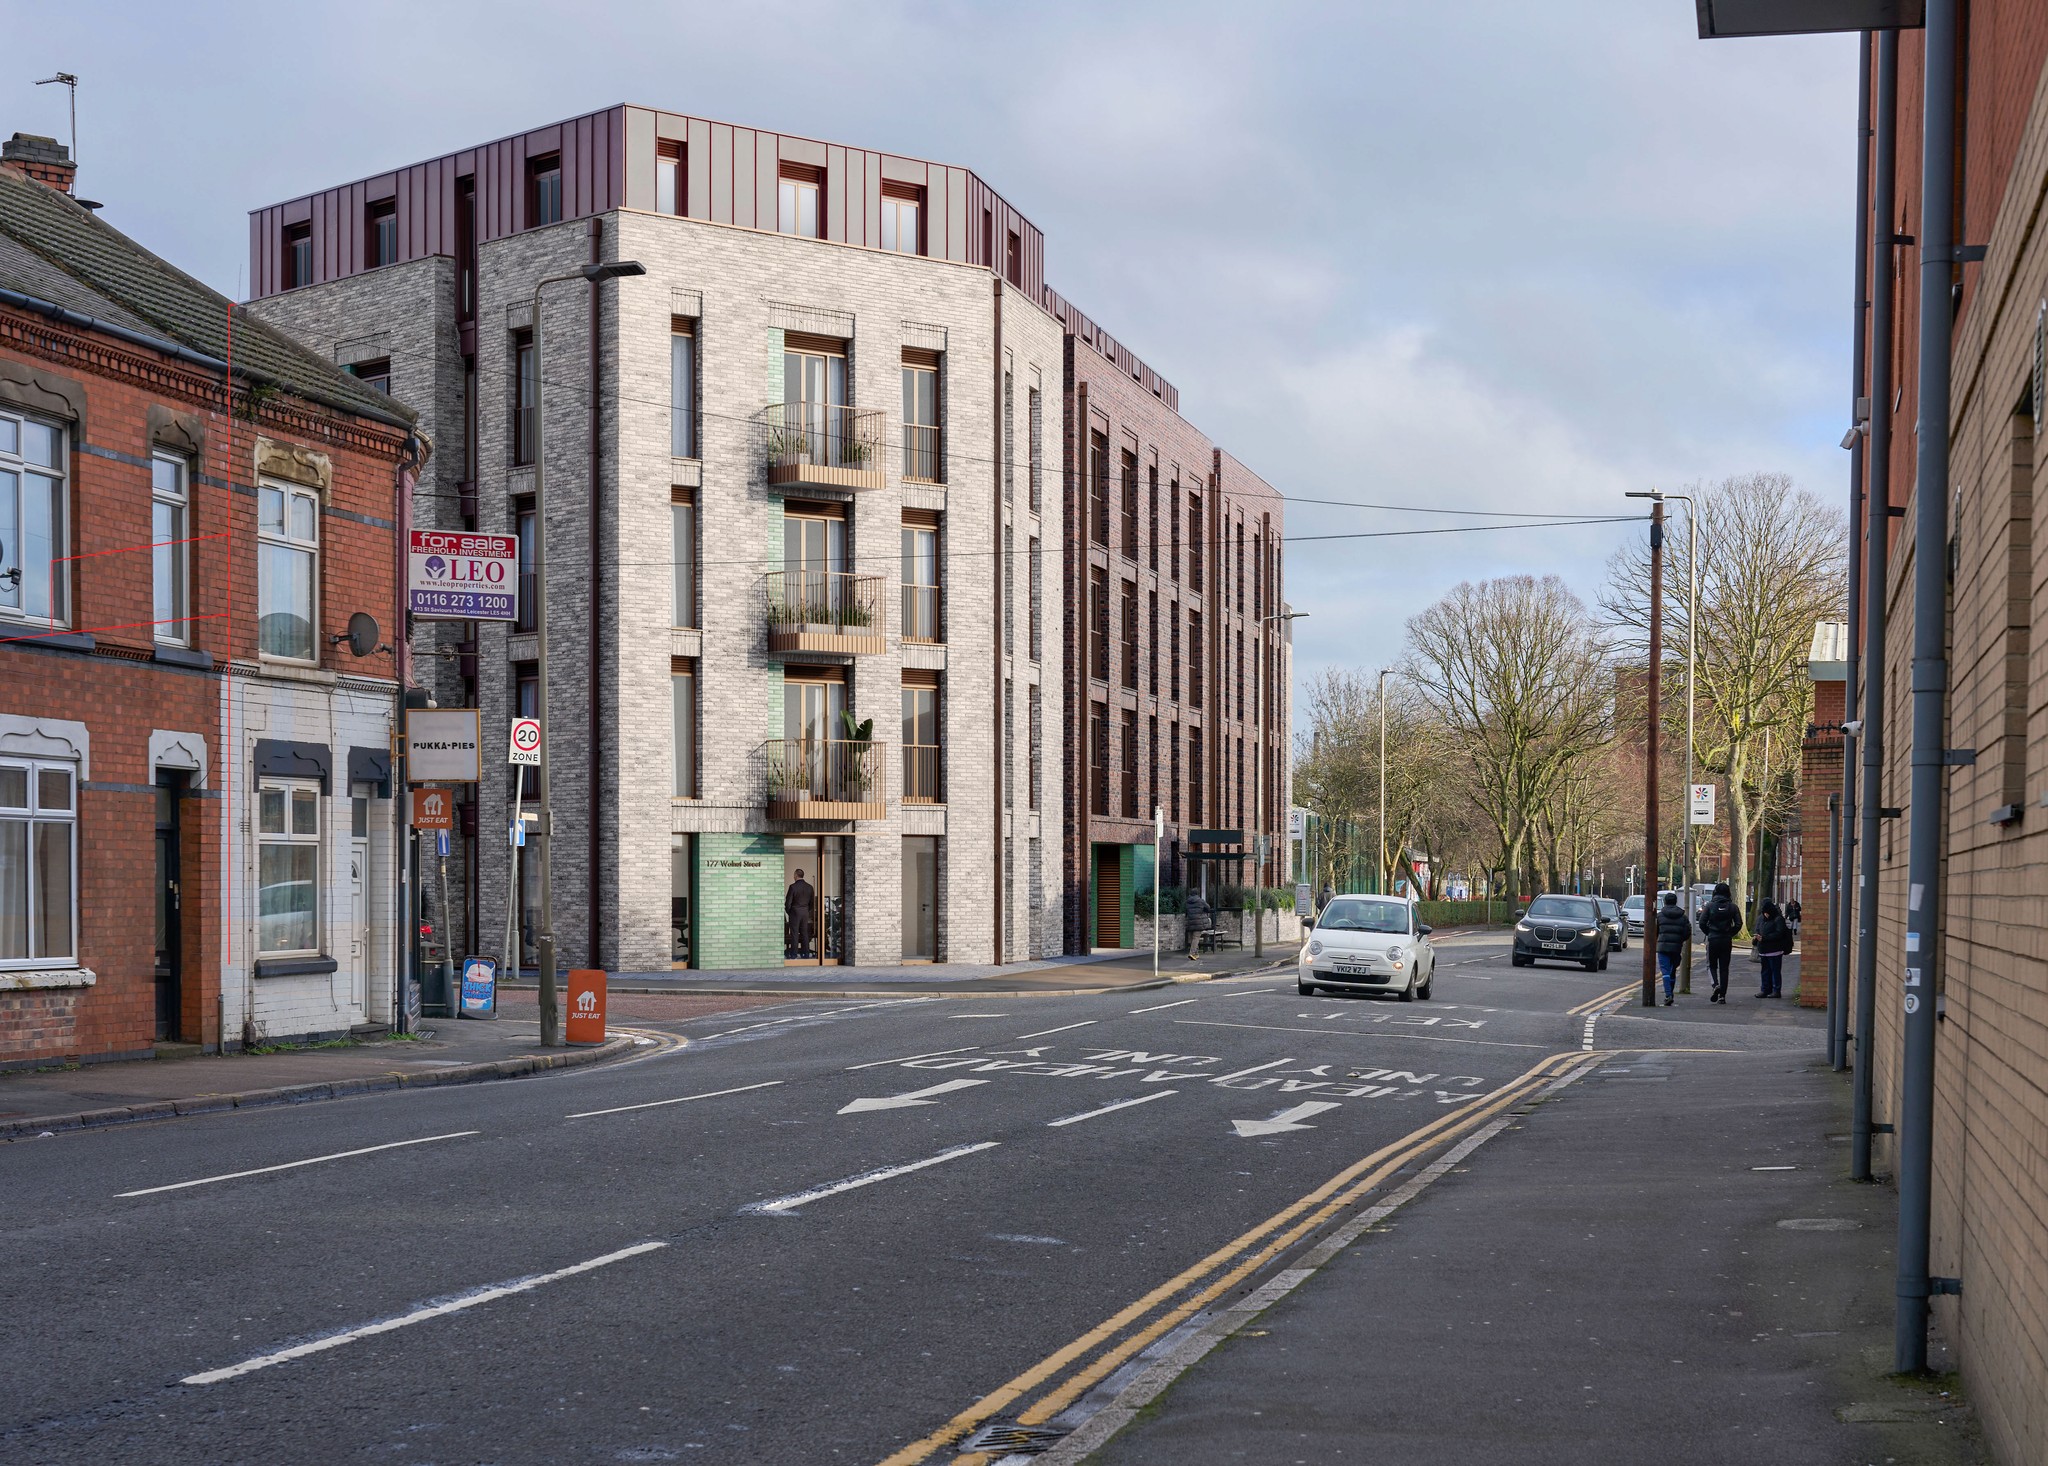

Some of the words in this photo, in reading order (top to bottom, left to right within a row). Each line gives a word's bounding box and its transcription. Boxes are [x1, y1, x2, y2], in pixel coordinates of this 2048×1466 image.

[419, 532, 457, 548] for
[460, 536, 507, 551] sale
[411, 545, 458, 556] FREEHOLD
[459, 548, 512, 558] INVESTMENT
[448, 558, 505, 583] LEO
[420, 580, 506, 591] www.leoproperties.com
[417, 592, 447, 606] 0116
[450, 594, 474, 607] 273
[478, 595, 508, 609] 1200
[517, 729, 538, 743] 20
[413, 741, 475, 750] PUKKA-PIES
[512, 752, 538, 762] ZONE
[707, 860, 719, 868] 177
[743, 860, 761, 868] Street
[1336, 965, 1351, 974] VK12
[1352, 966, 1367, 974] WZJ
[464, 982, 492, 993] THICK
[1296, 1011, 1489, 1030] KEEP
[900, 1057, 1215, 1082] AHEAD
